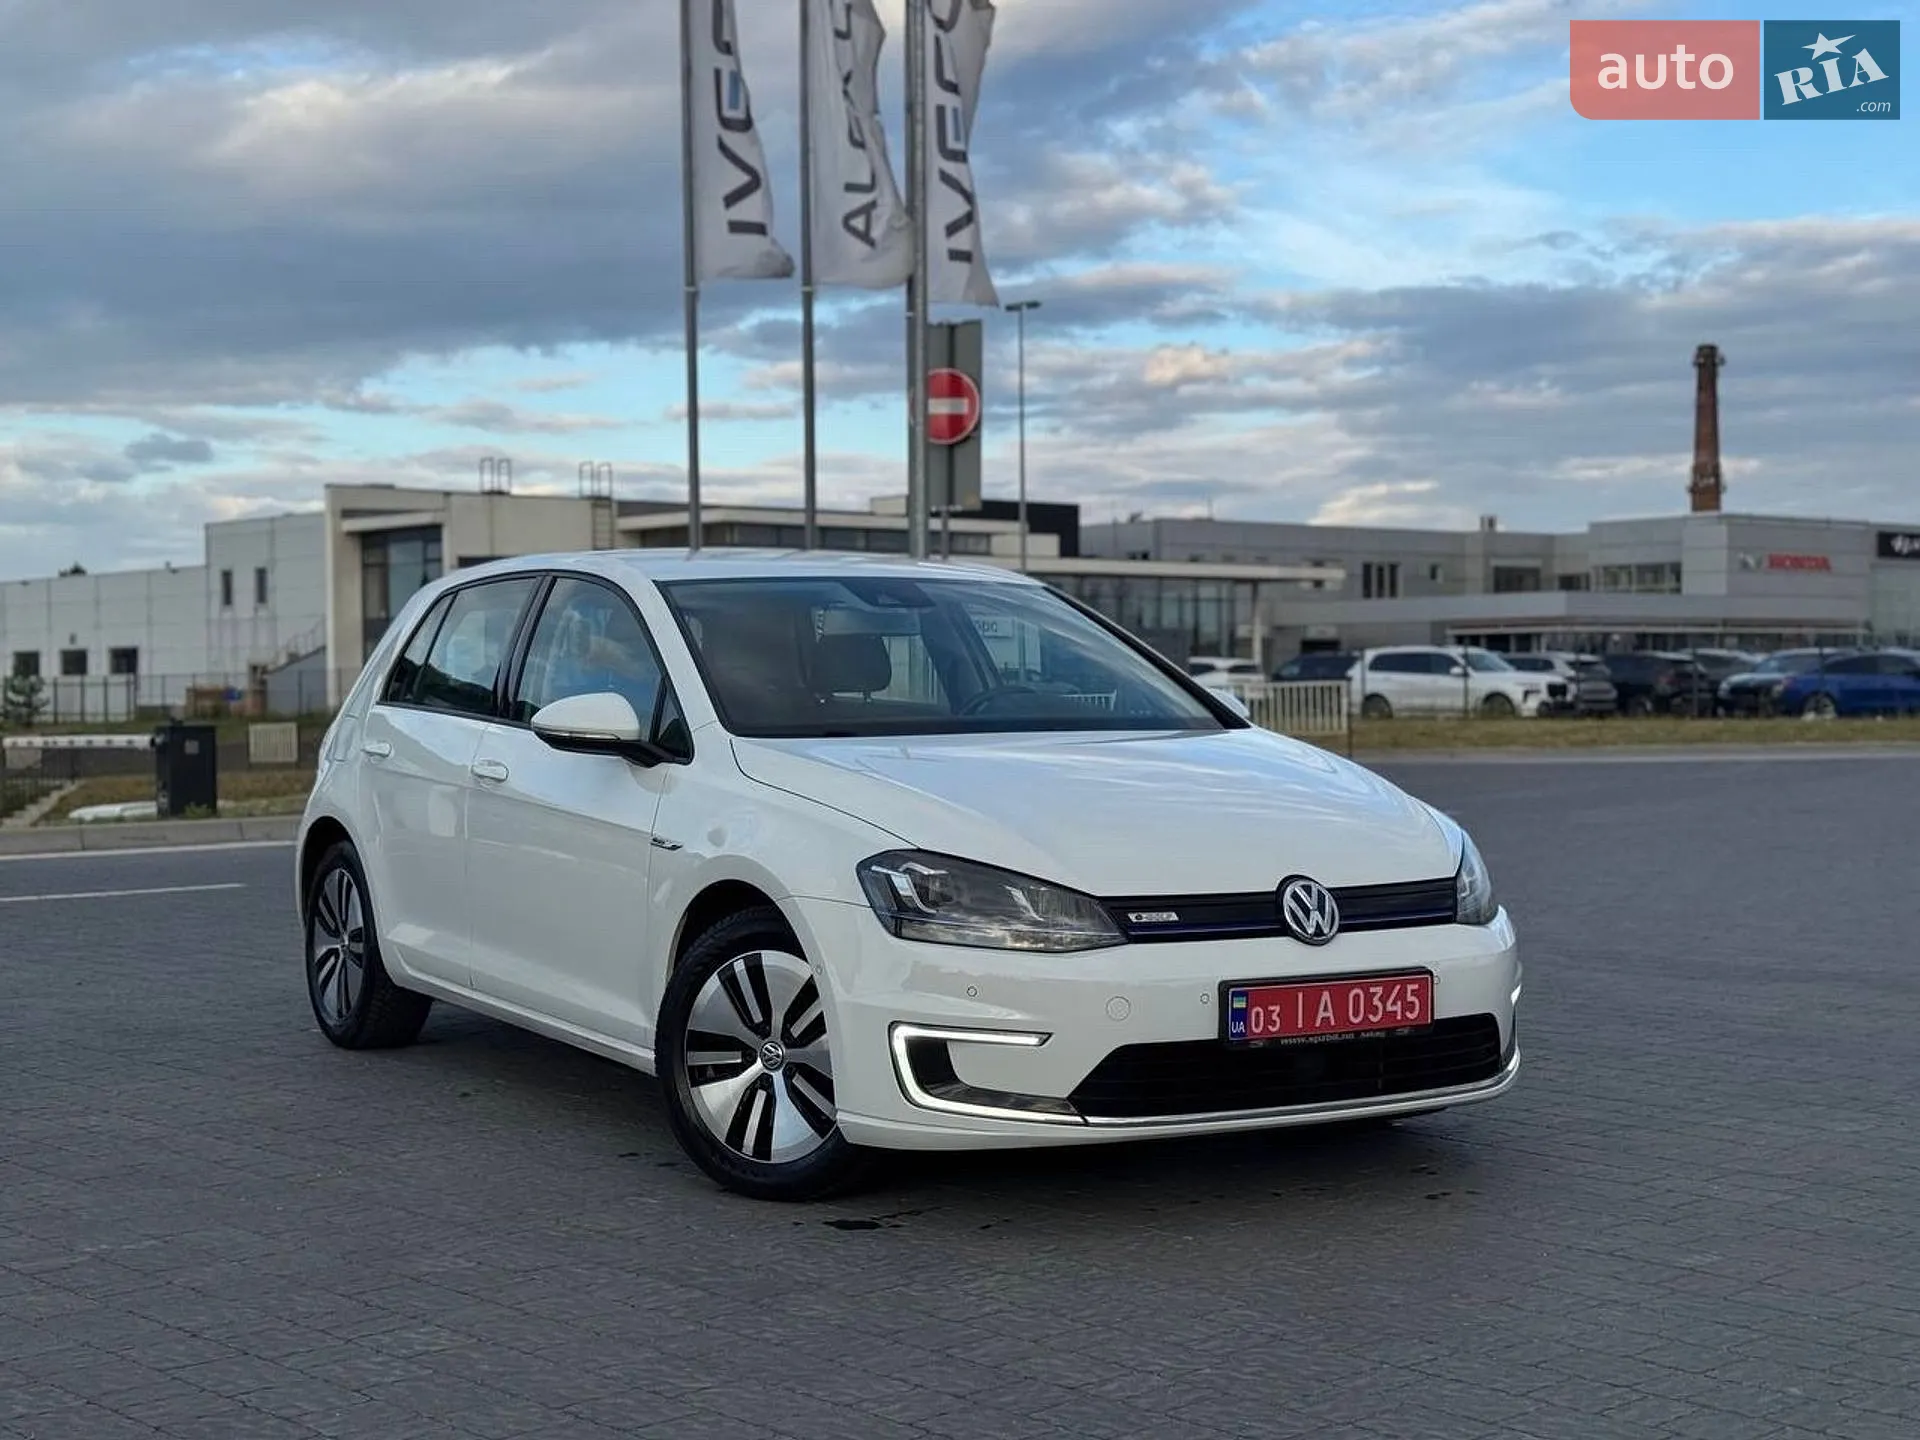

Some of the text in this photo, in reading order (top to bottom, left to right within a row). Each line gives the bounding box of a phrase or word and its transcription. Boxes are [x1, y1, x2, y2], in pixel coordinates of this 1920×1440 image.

[1251, 1006, 1281, 1033] 03
[1348, 984, 1420, 1024] 0345
[1231, 1021, 1246, 1034] UA
